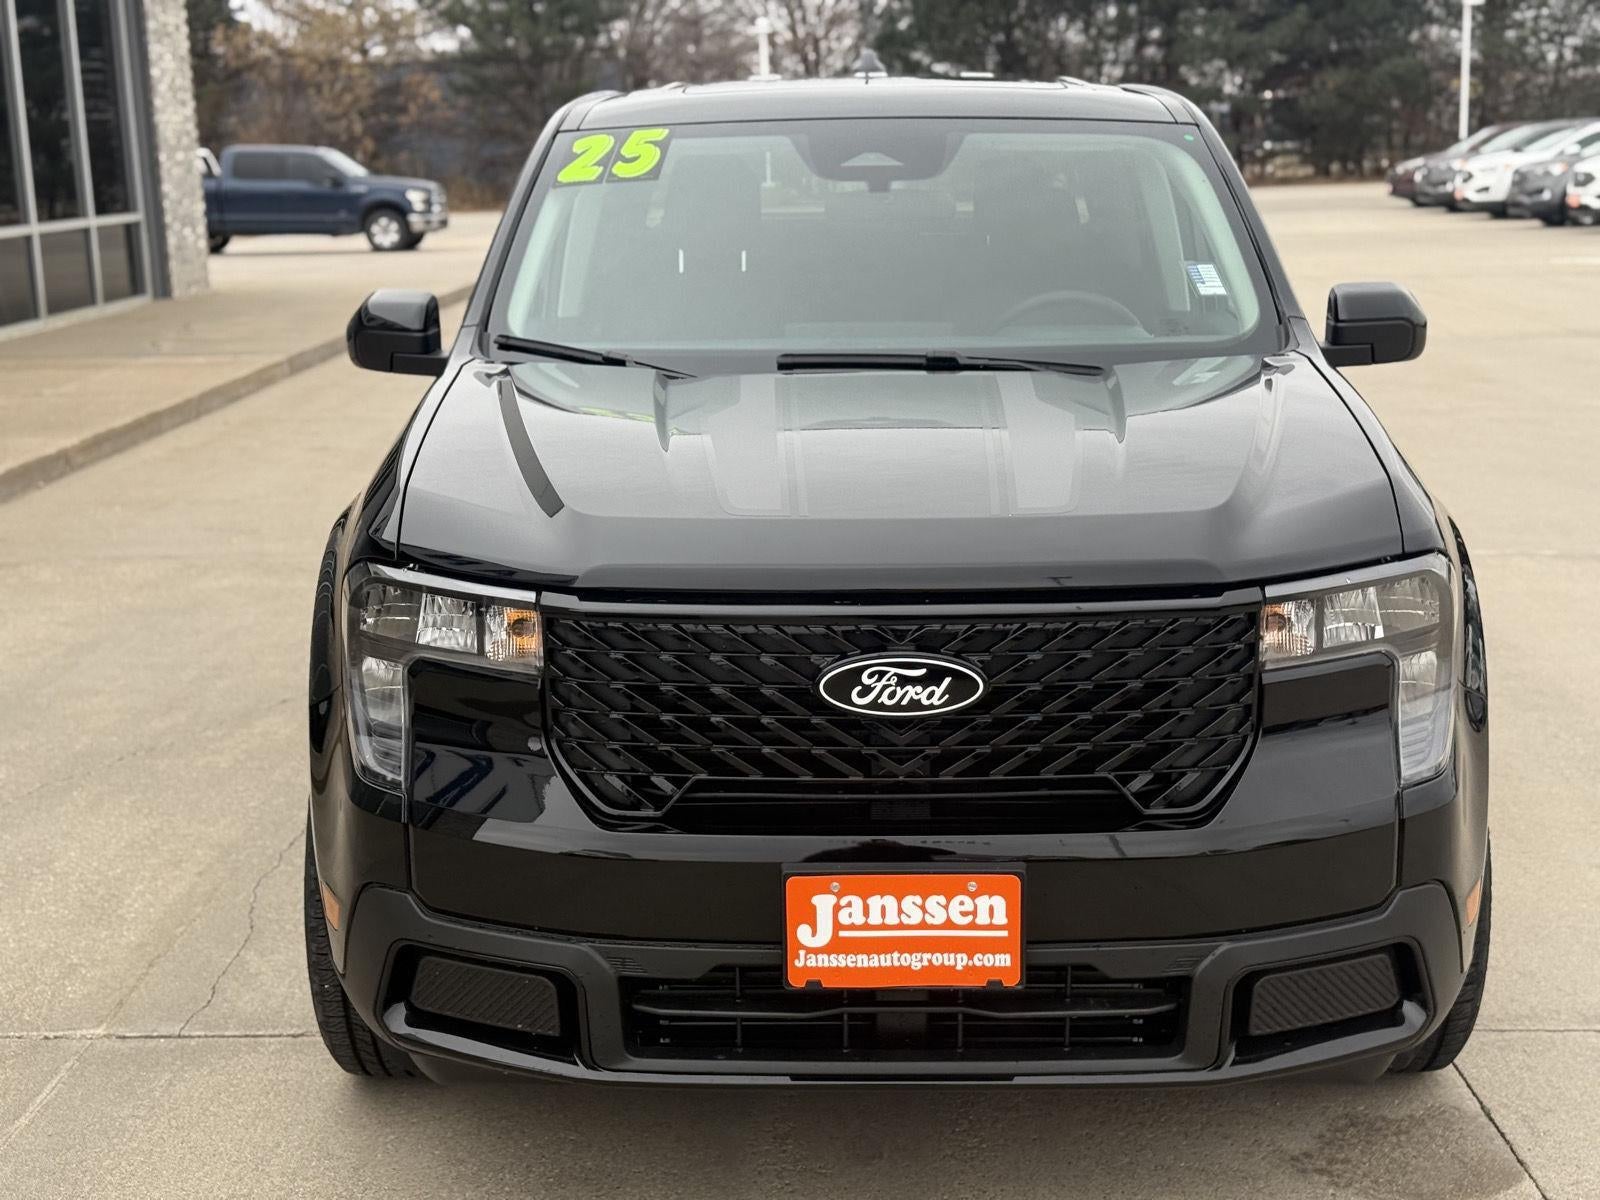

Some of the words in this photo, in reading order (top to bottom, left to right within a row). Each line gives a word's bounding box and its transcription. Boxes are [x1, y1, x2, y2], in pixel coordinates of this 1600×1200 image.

[557, 128, 669, 183] 25
[851, 666, 952, 705] Ford
[797, 894, 1008, 947] Janssen
[795, 950, 1011, 970] Janssenautogroup.com
